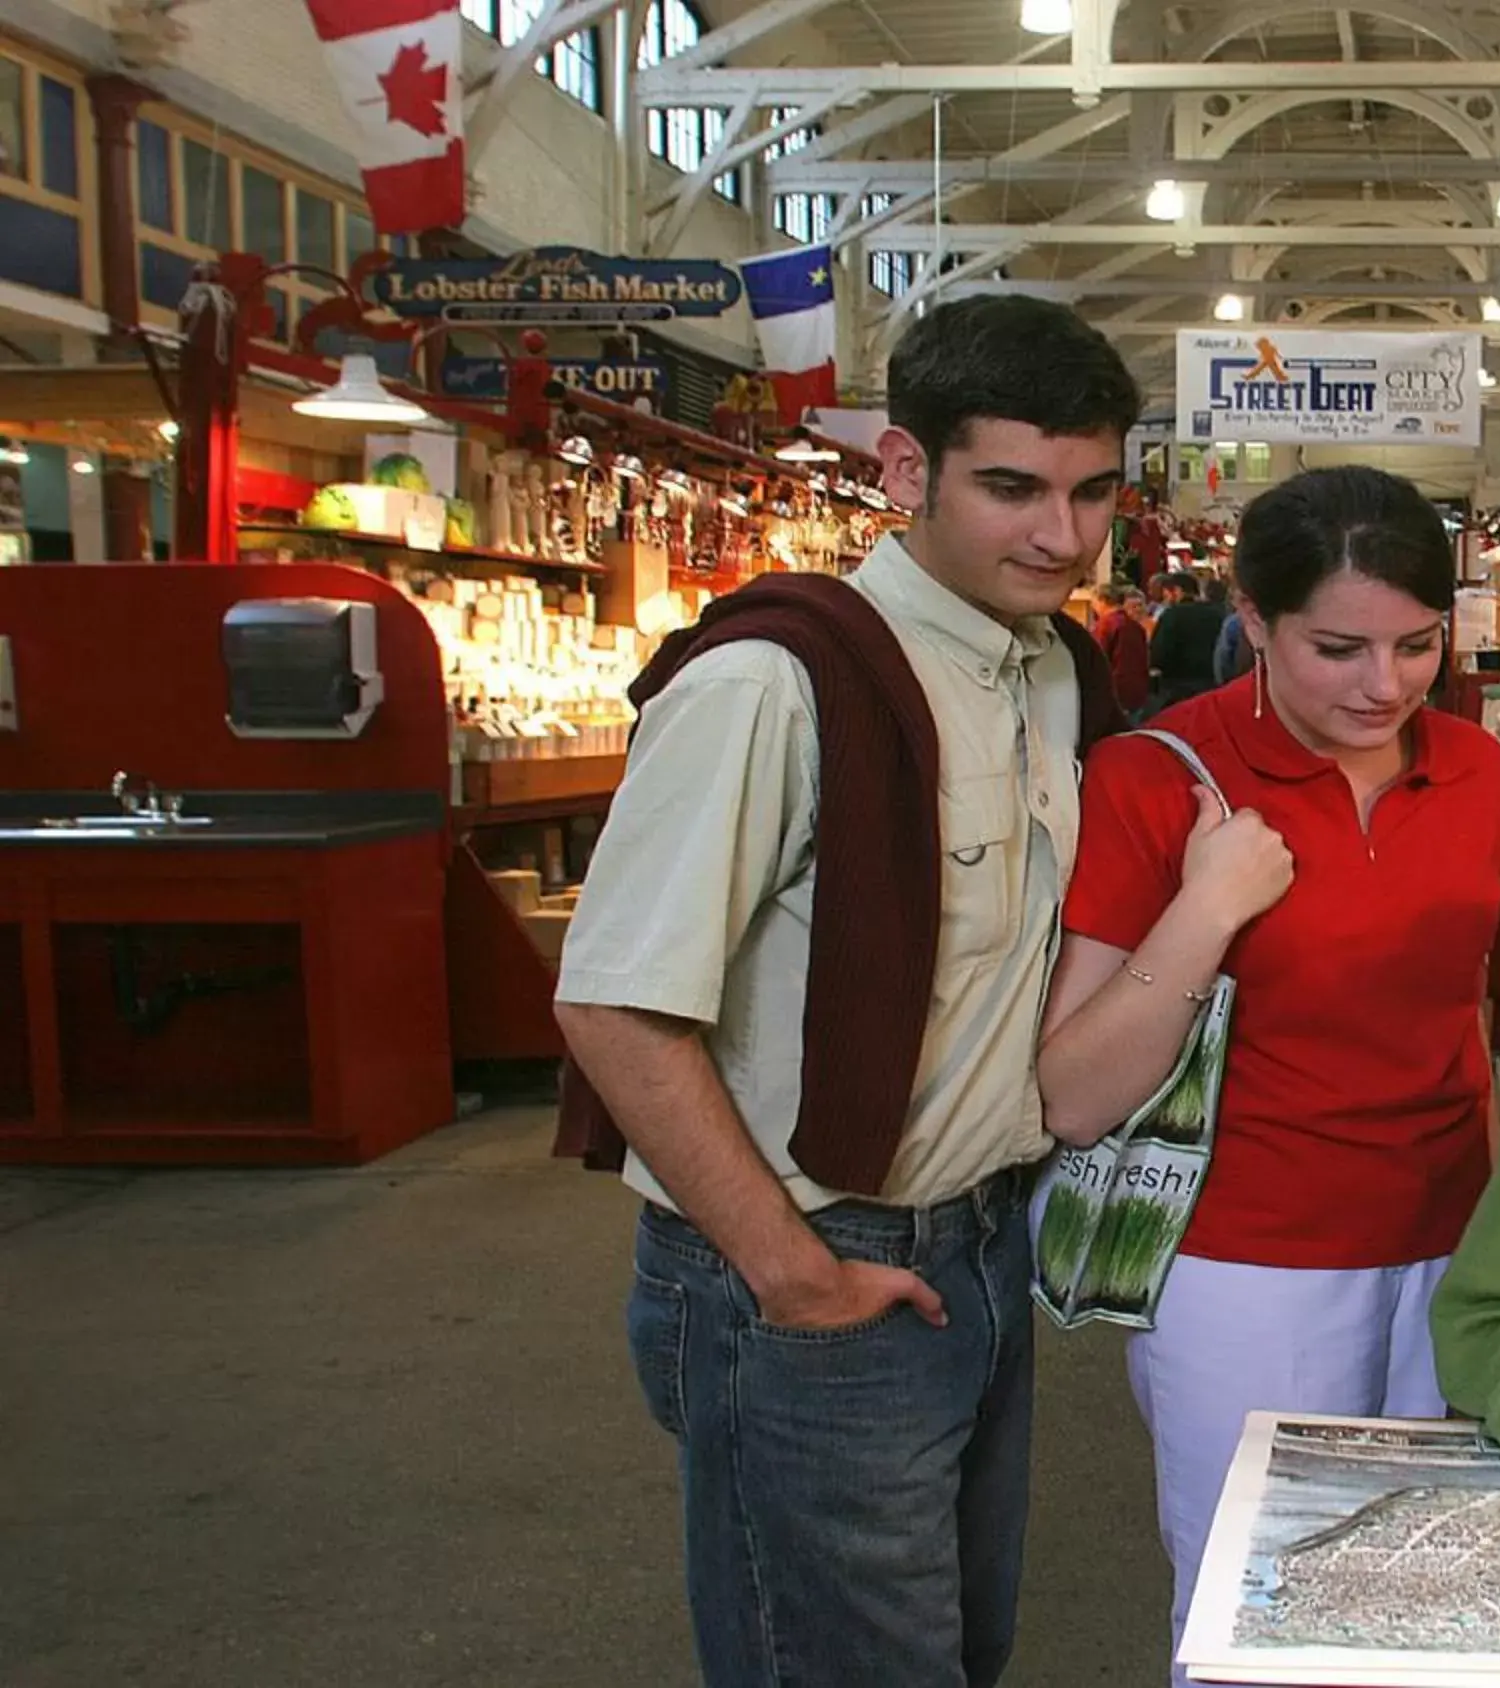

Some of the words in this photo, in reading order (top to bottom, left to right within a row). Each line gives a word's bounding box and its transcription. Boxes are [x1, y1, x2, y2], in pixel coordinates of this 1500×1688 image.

[389, 275, 519, 300] Lobster
[541, 275, 609, 301] Fish
[615, 275, 727, 301] Market
[1385, 369, 1454, 390] CITY
